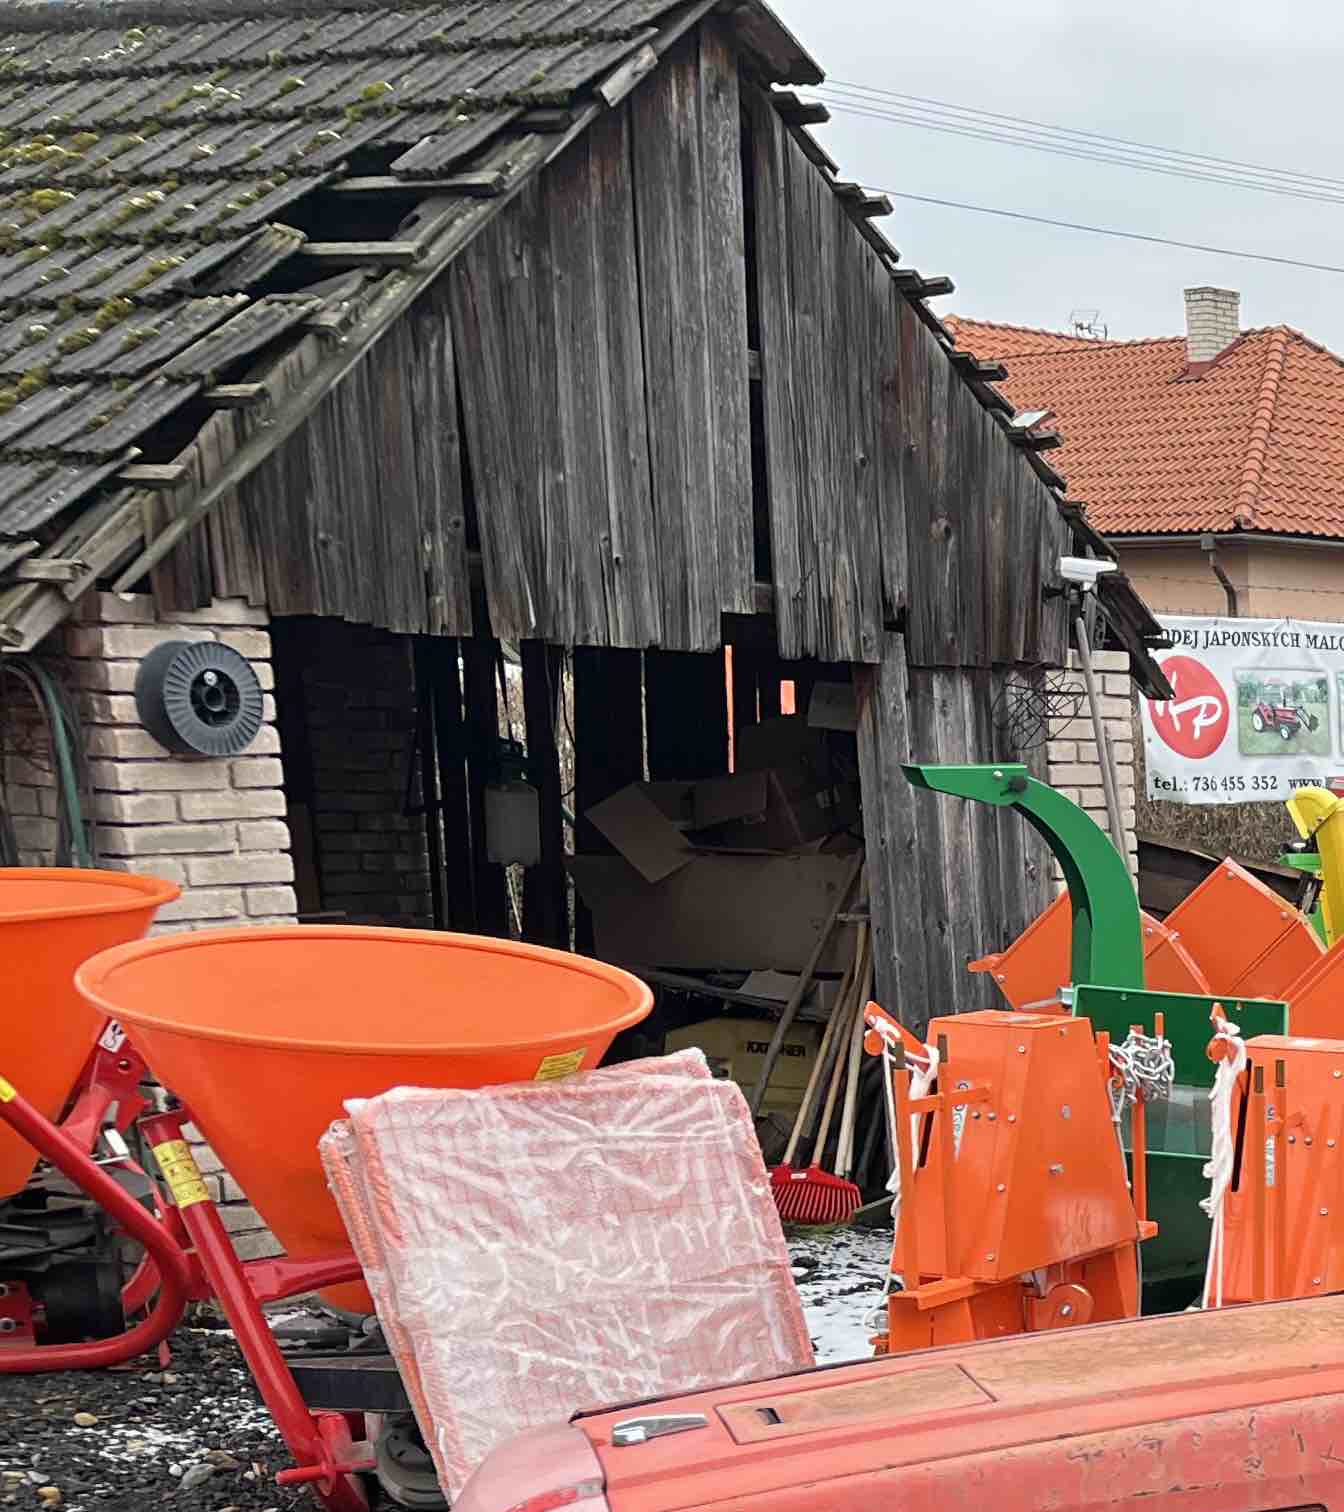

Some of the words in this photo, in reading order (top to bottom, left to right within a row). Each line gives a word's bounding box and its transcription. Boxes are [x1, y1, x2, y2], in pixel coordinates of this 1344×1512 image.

[1161, 629, 1199, 650] ODEJ
[1152, 776, 1189, 792] tel.:
[1192, 776, 1218, 792] 736
[1221, 775, 1246, 791] 455
[1251, 775, 1279, 791] 352
